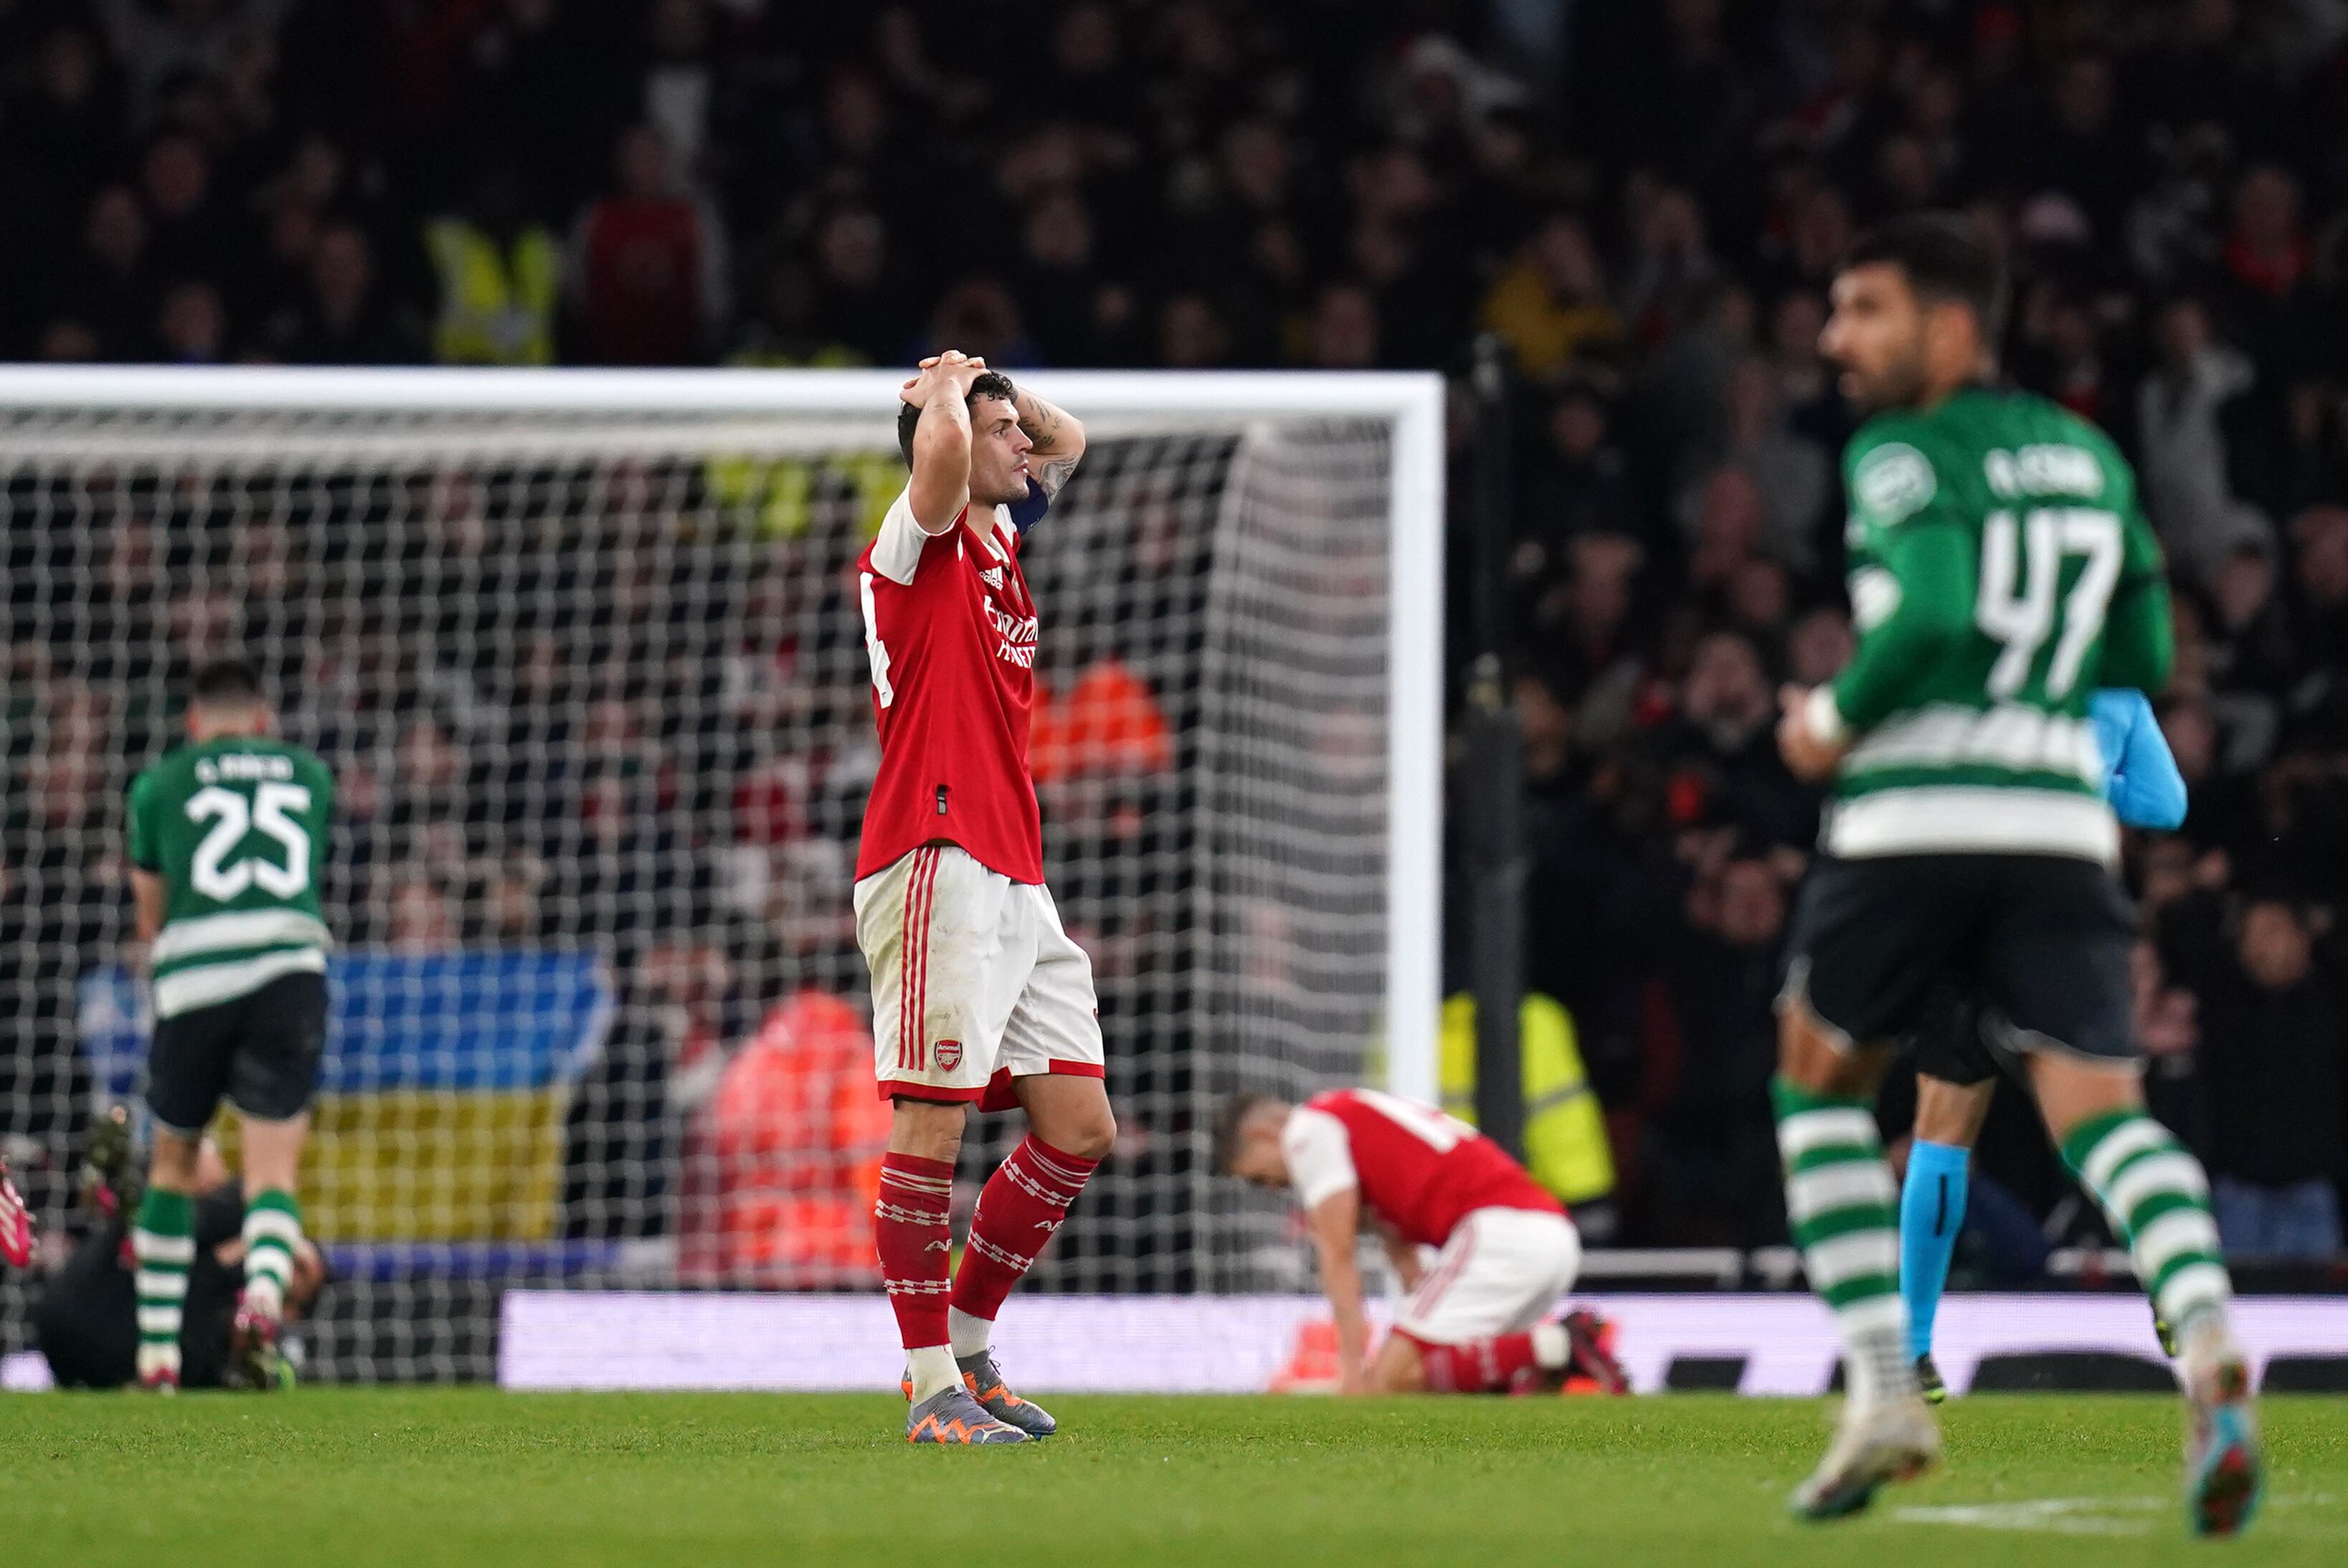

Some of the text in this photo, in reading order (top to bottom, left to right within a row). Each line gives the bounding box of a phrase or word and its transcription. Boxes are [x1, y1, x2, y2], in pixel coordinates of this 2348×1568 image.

[979, 571, 1003, 591] adida
[1977, 506, 2123, 700] 47
[184, 786, 311, 901] 25
